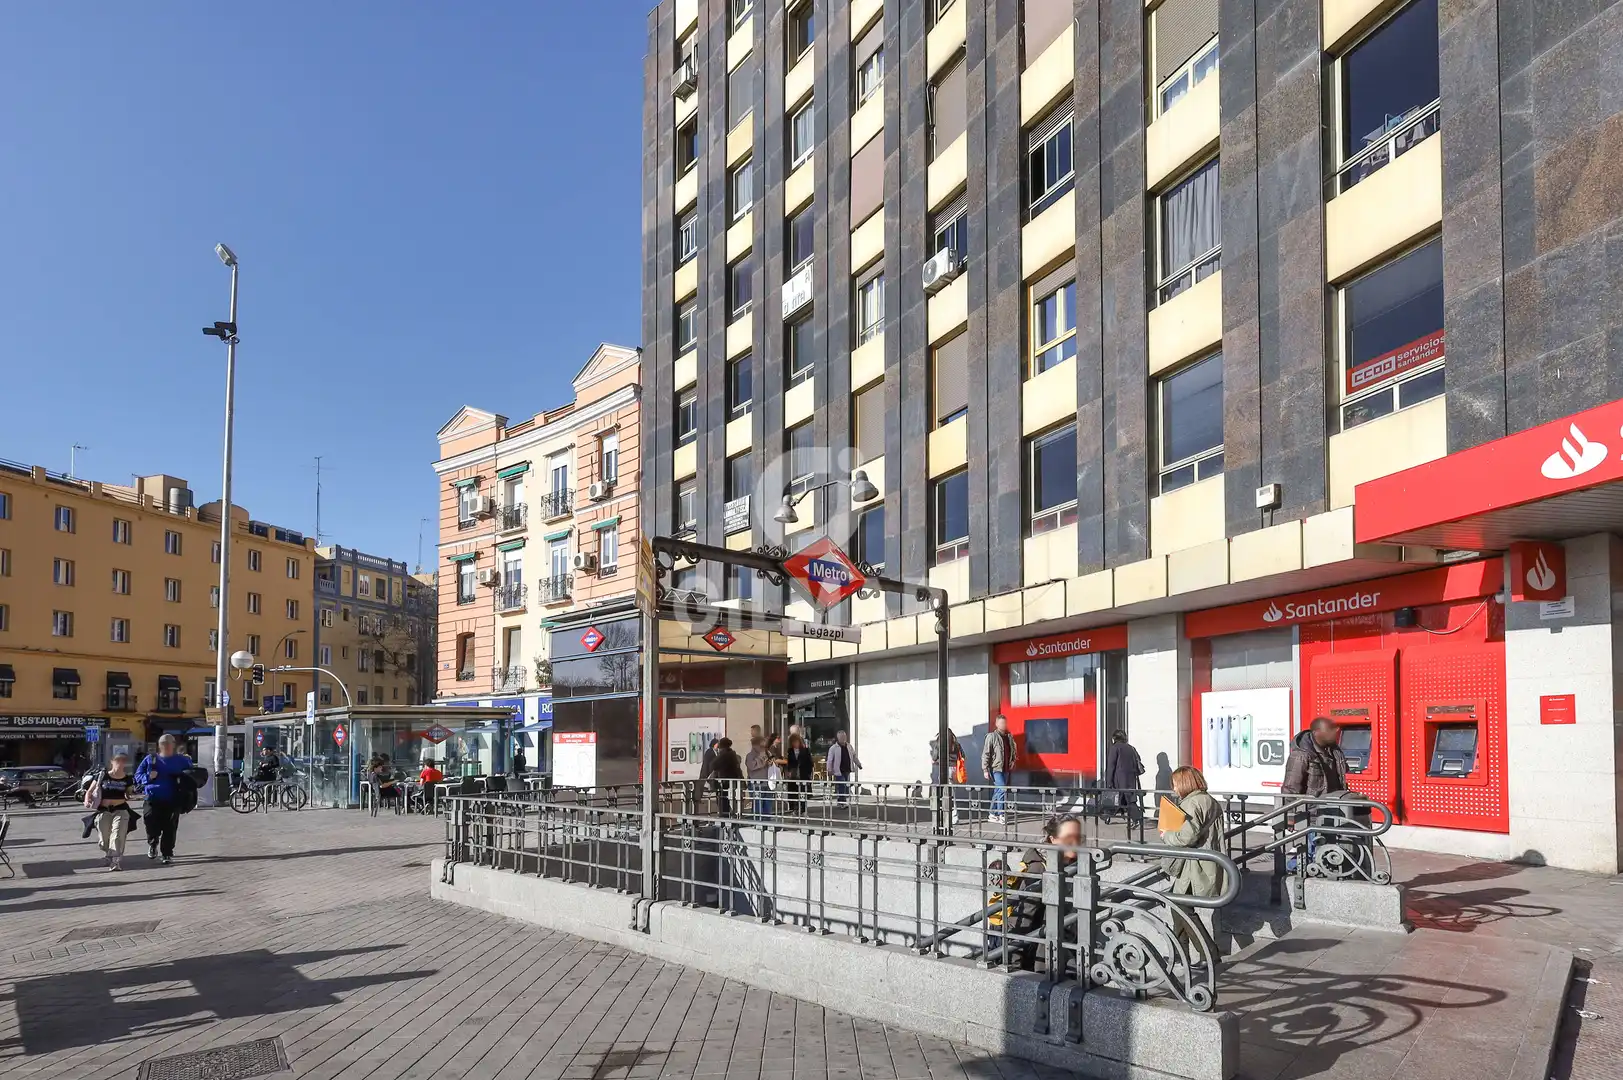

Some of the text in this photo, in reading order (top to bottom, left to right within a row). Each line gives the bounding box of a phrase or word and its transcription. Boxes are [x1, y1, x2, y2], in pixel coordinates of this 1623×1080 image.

[1397, 335, 1445, 361] servicios
[1397, 347, 1439, 369] santander
[1352, 356, 1396, 387] CCOO
[813, 562, 847, 582] Metro
[1285, 592, 1381, 619] Santander
[803, 624, 844, 640] Legazpi
[1039, 638, 1092, 655] Santander
[13, 716, 84, 726] RESTAURANTE
